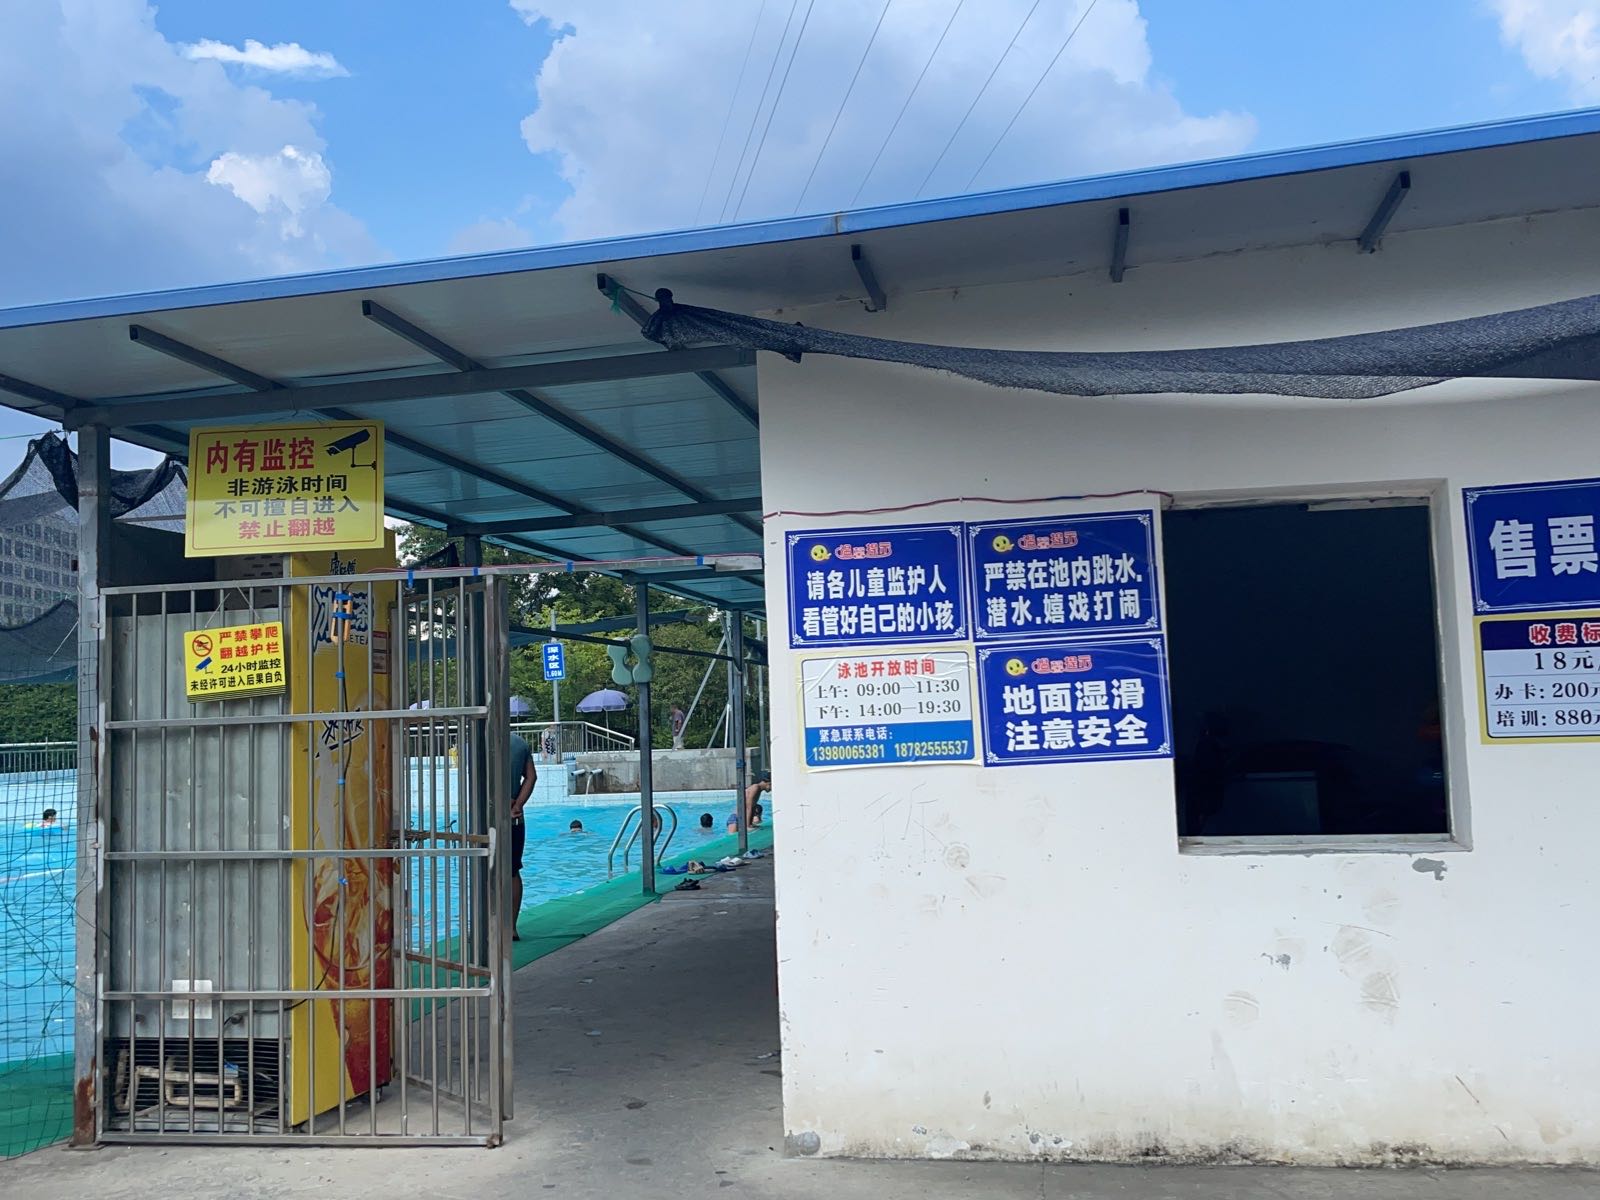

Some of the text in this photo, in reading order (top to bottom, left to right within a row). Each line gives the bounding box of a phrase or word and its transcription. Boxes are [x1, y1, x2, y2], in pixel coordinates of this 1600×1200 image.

[206, 436, 315, 474] 内有监控
[227, 474, 347, 496] 非游泳时间
[214, 495, 360, 519] 不可擅自进入
[238, 517, 336, 539] 禁止翻越
[1488, 514, 1599, 580] 售票
[806, 564, 947, 600] 请各儿童监护人
[803, 600, 954, 637] 看管好自己的小孩
[219, 626, 279, 643] 严禁攀爬
[220, 642, 280, 659] 翻越护栏
[1534, 650, 1600, 671] 18元
[221, 658, 282, 674] 24小时监控
[837, 658, 936, 679] 泳池开放时间
[191, 671, 283, 692] 未经许可进入后果自负
[1002, 678, 1145, 715] 地面湿滑
[819, 726, 893, 743] 紧急联系电话：
[1005, 713, 1149, 752] 注意安全
[812, 740, 968, 761] 13980065381 18782555537
